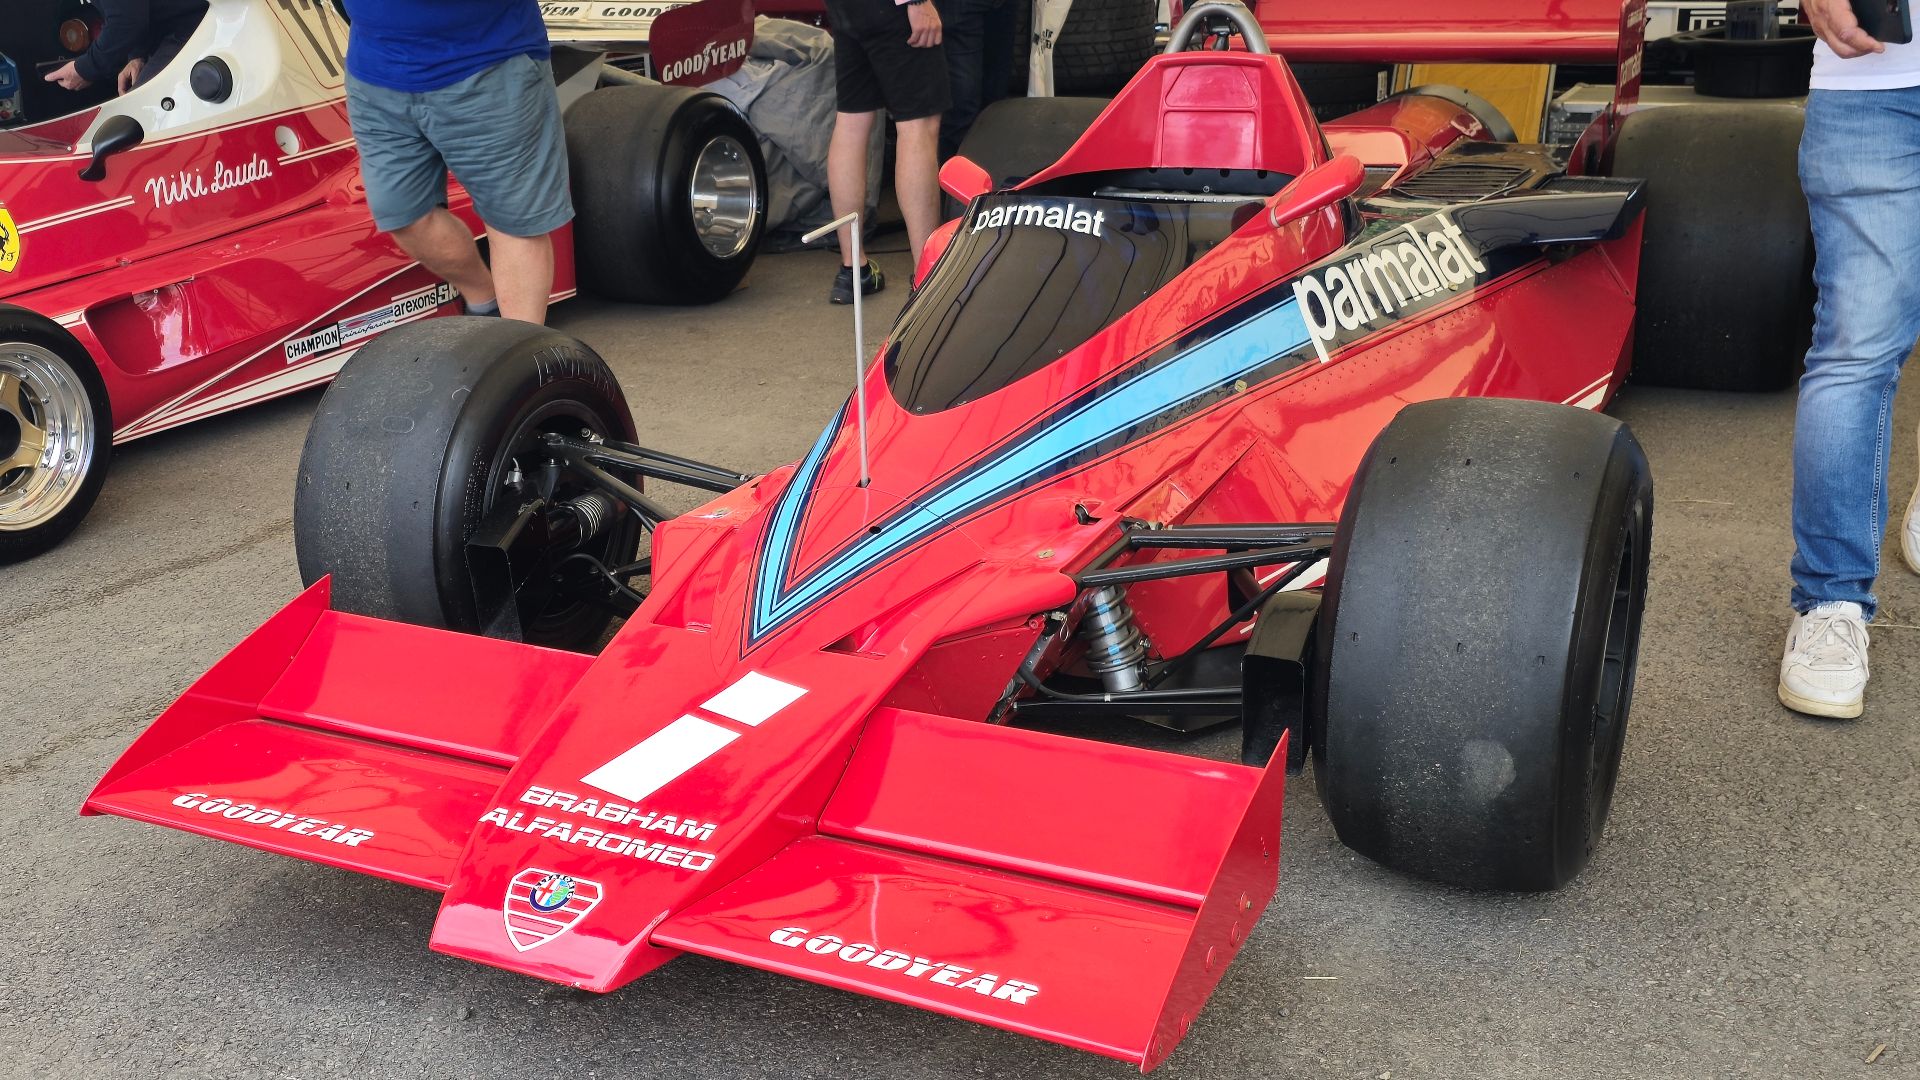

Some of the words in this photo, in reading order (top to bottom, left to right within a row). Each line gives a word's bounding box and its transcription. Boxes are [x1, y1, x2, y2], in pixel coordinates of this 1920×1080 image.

[144, 169, 208, 208] Niki
[210, 153, 273, 193] Lauda
[970, 203, 1105, 237] parmalat
[393, 291, 437, 317] arexons
[1292, 213, 1487, 364] parmalat
[286, 329, 339, 359] CHAMPION
[172, 792, 375, 847] GOODYEAR
[519, 785, 718, 842] BRABHAM
[768, 926, 1041, 1005] GOODYEAR
